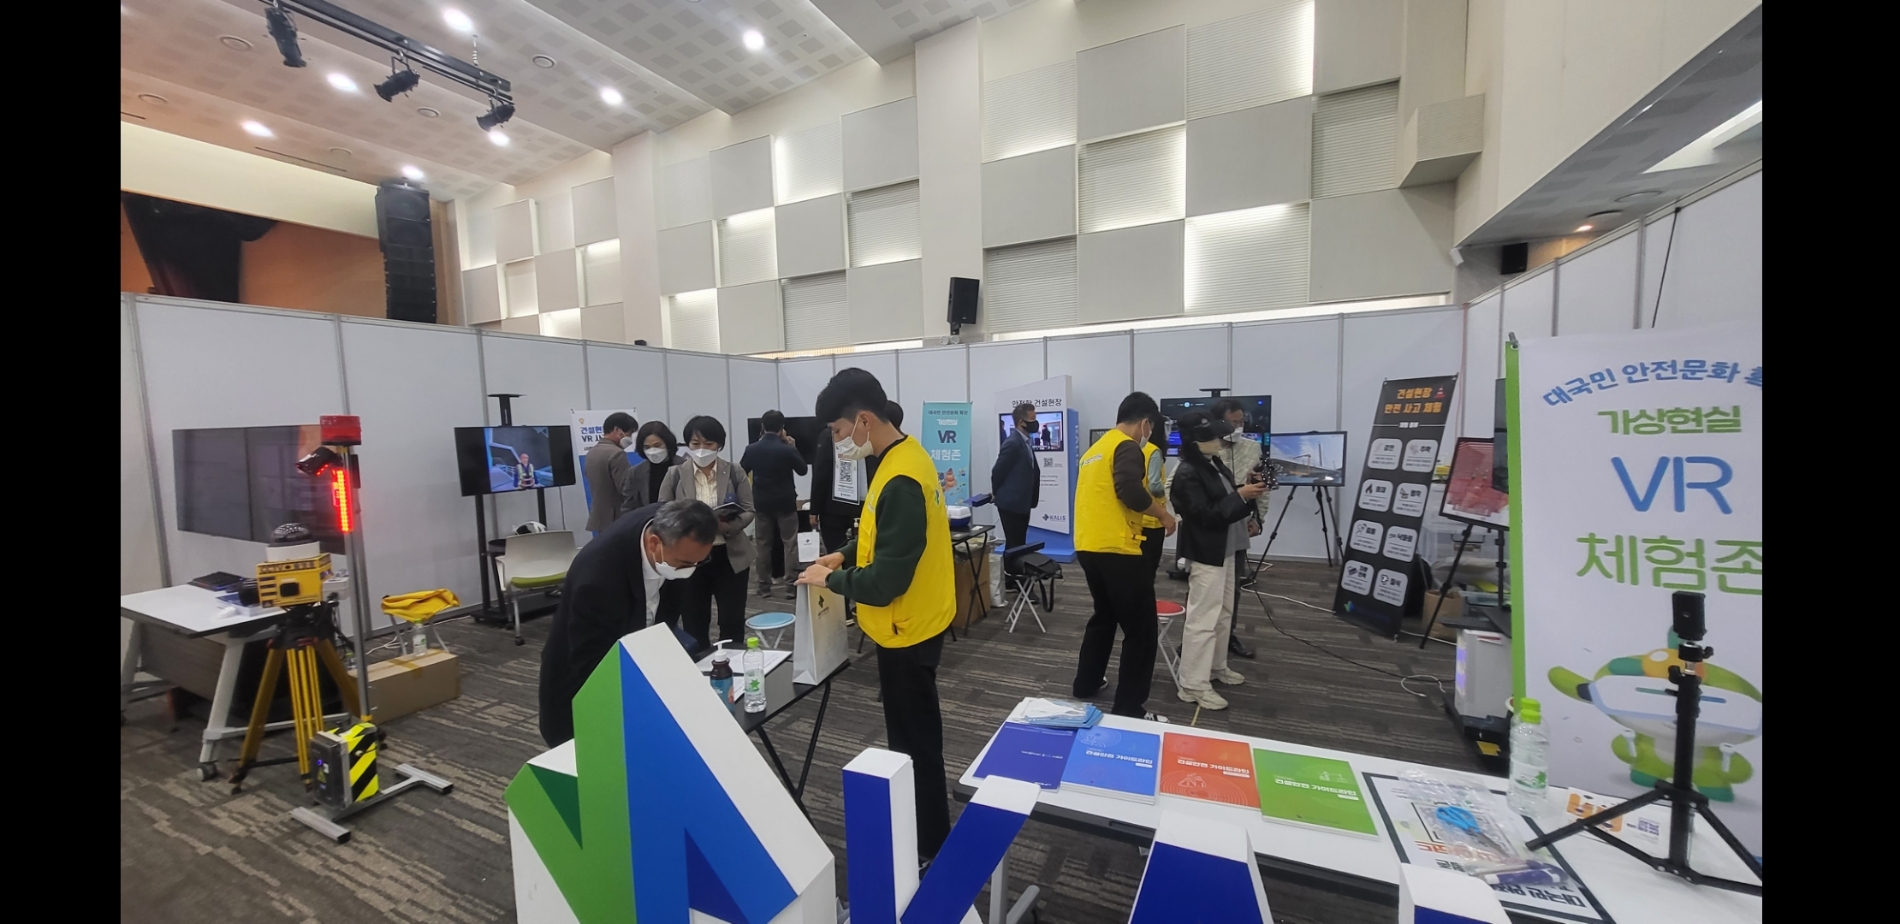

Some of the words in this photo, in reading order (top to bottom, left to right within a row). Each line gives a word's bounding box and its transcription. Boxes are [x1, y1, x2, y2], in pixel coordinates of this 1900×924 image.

[1542, 368, 1619, 406] 대국민
[1621, 359, 1741, 384] 안전문화
[1396, 387, 1433, 399] 건설현장
[1034, 398, 1062, 408] 건설현장
[1403, 403, 1421, 413] 사고
[1598, 405, 1742, 435] 가상현실
[580, 426, 603, 434] 건설현
[938, 430, 957, 443] VR
[930, 449, 961, 461] 체험존
[1611, 455, 1733, 515] VR
[1576, 532, 1763, 595] 체험존
[1115, 755, 1153, 765] 가이드라인
[1209, 763, 1250, 774] 가이드라인
[1311, 784, 1358, 796] 가이드라인
[1526, 886, 1587, 908] 대국민
